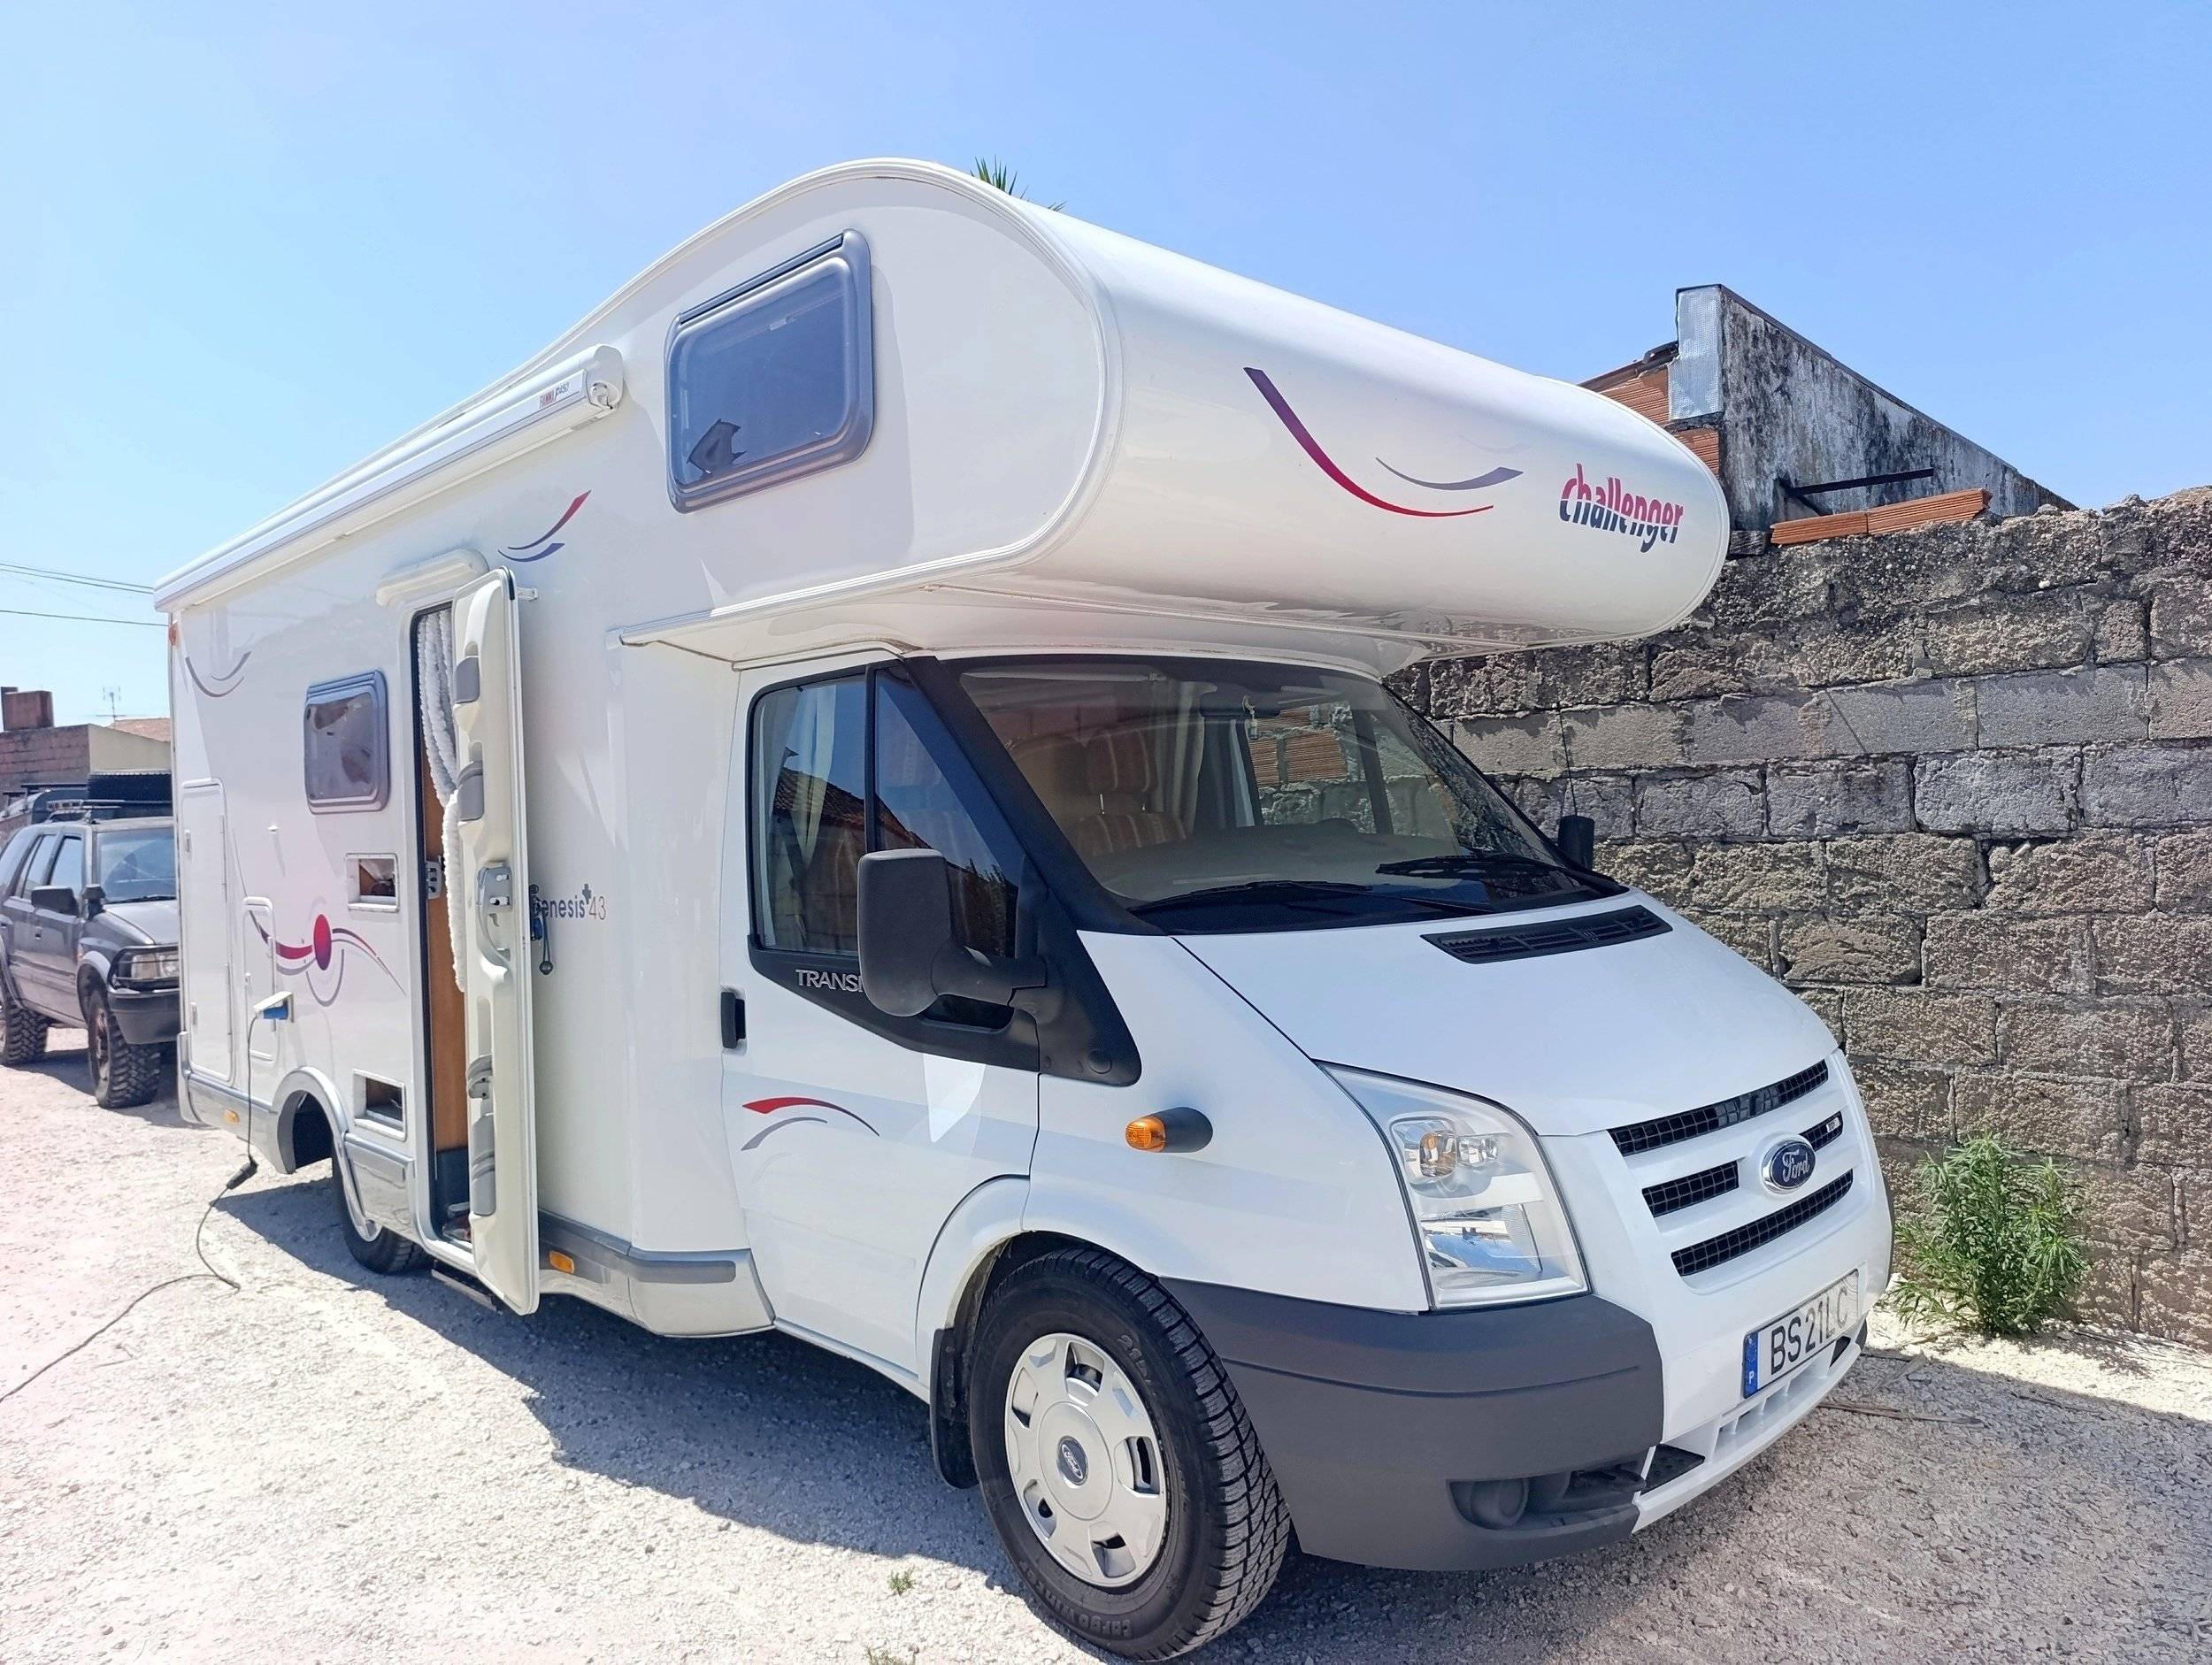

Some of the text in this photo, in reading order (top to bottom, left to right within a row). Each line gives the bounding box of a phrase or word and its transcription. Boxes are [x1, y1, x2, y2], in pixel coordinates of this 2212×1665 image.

[588, 895, 606, 920] 43
[1782, 1148, 1809, 1183] Ford
[1748, 1370, 1755, 1384] P
